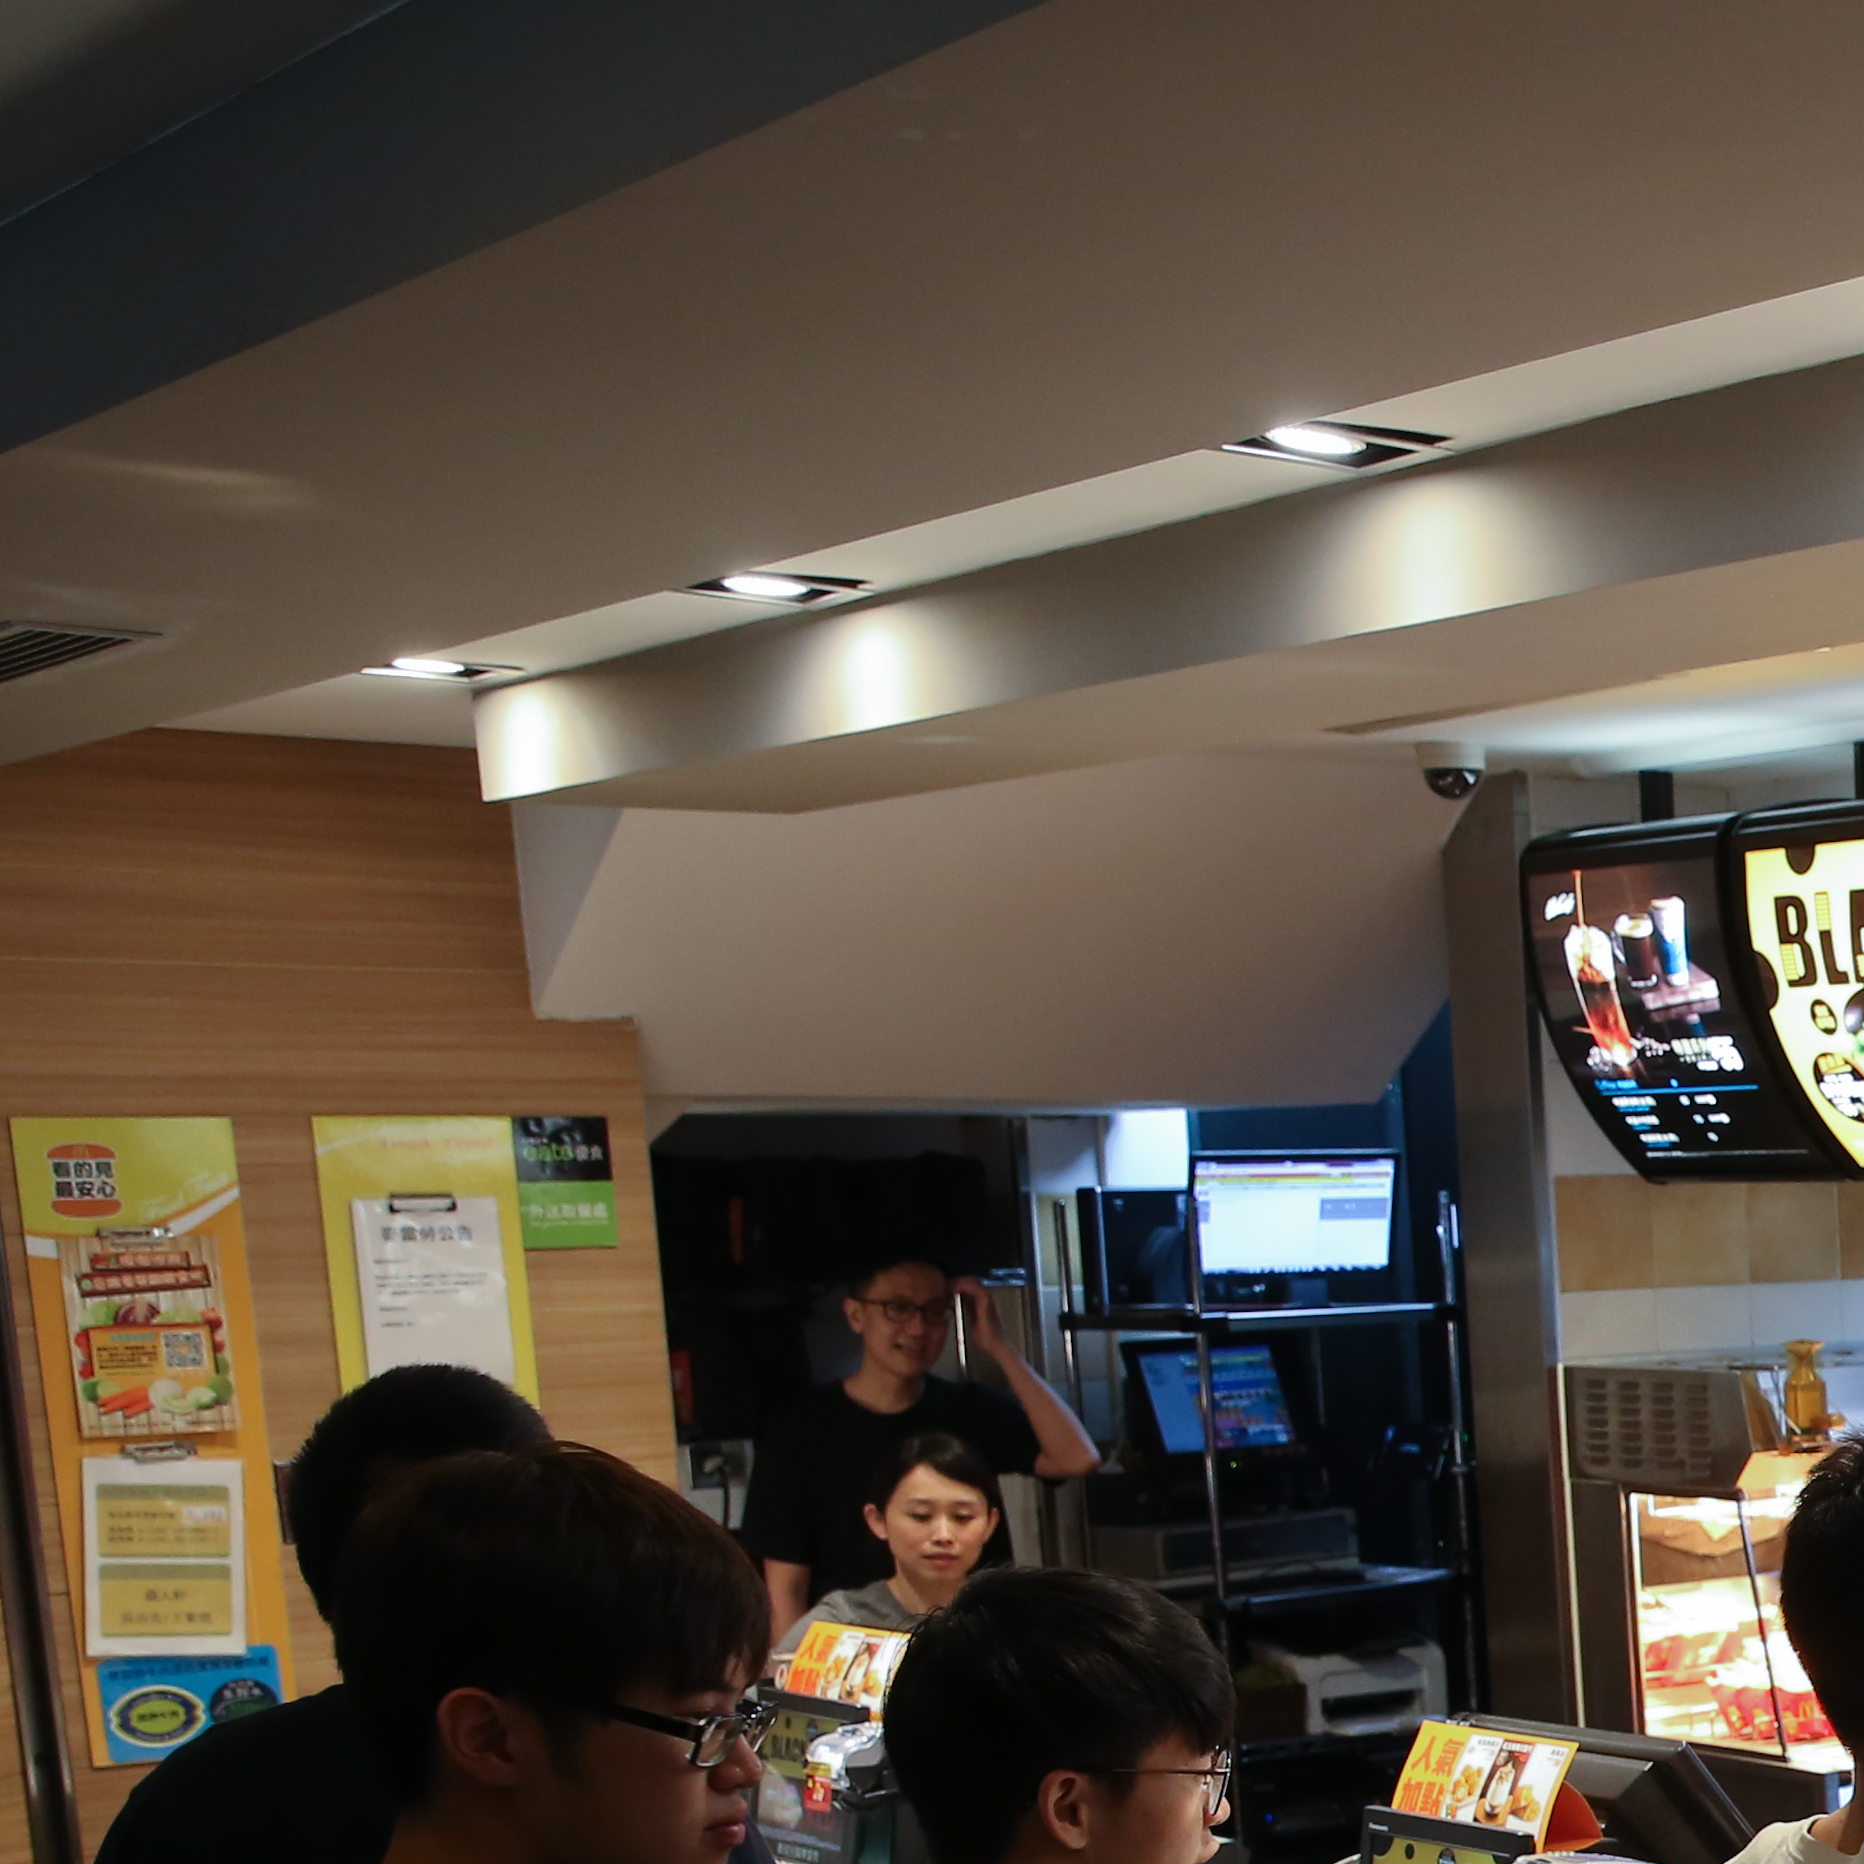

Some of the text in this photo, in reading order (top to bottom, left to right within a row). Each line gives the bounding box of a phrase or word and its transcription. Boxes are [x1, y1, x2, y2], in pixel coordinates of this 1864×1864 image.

[52, 1161, 114, 1178] 看的見
[55, 1181, 116, 1198] 最安心
[1411, 1736, 1464, 1777] 人氣
[1395, 1778, 1447, 1816] 加點
